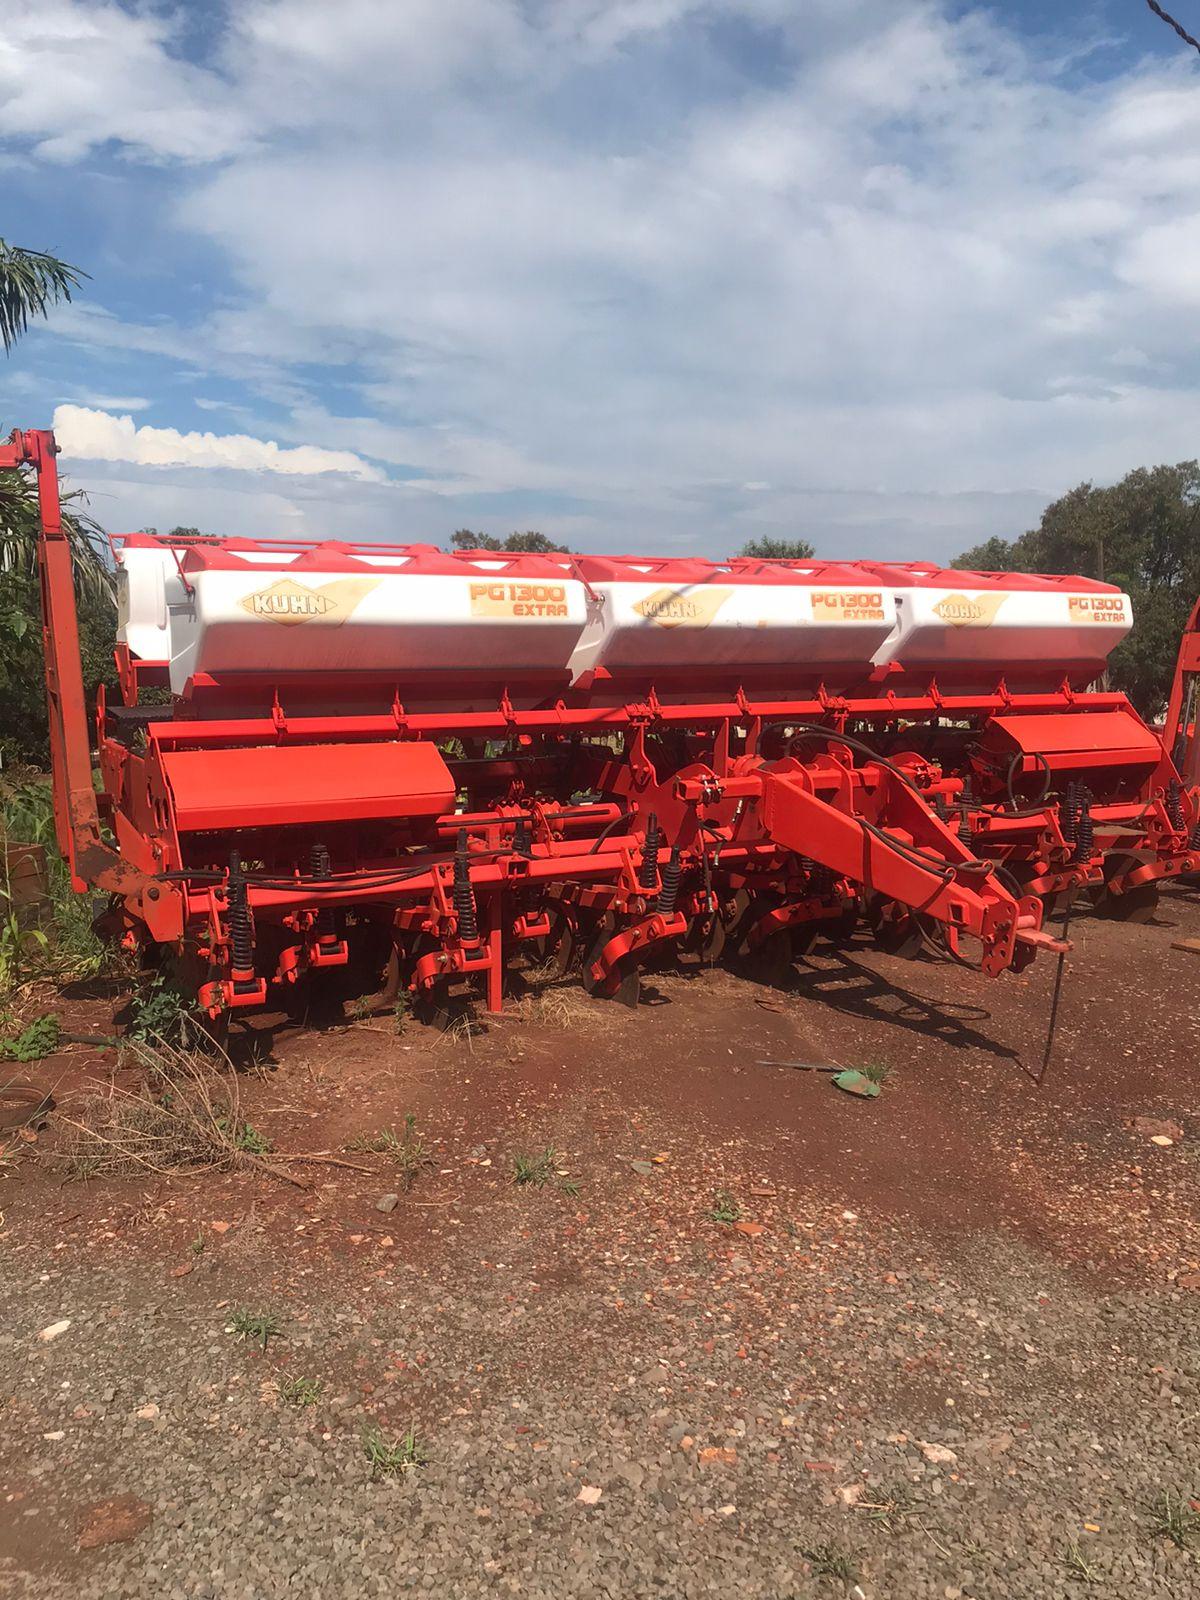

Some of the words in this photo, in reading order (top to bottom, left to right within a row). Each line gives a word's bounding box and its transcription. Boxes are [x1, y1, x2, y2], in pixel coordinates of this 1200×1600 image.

[253, 594, 326, 614] KUHN
[513, 604, 568, 616] EXTRA
[642, 601, 696, 617] KUHN
[1093, 612, 1125, 622] EXTRA
